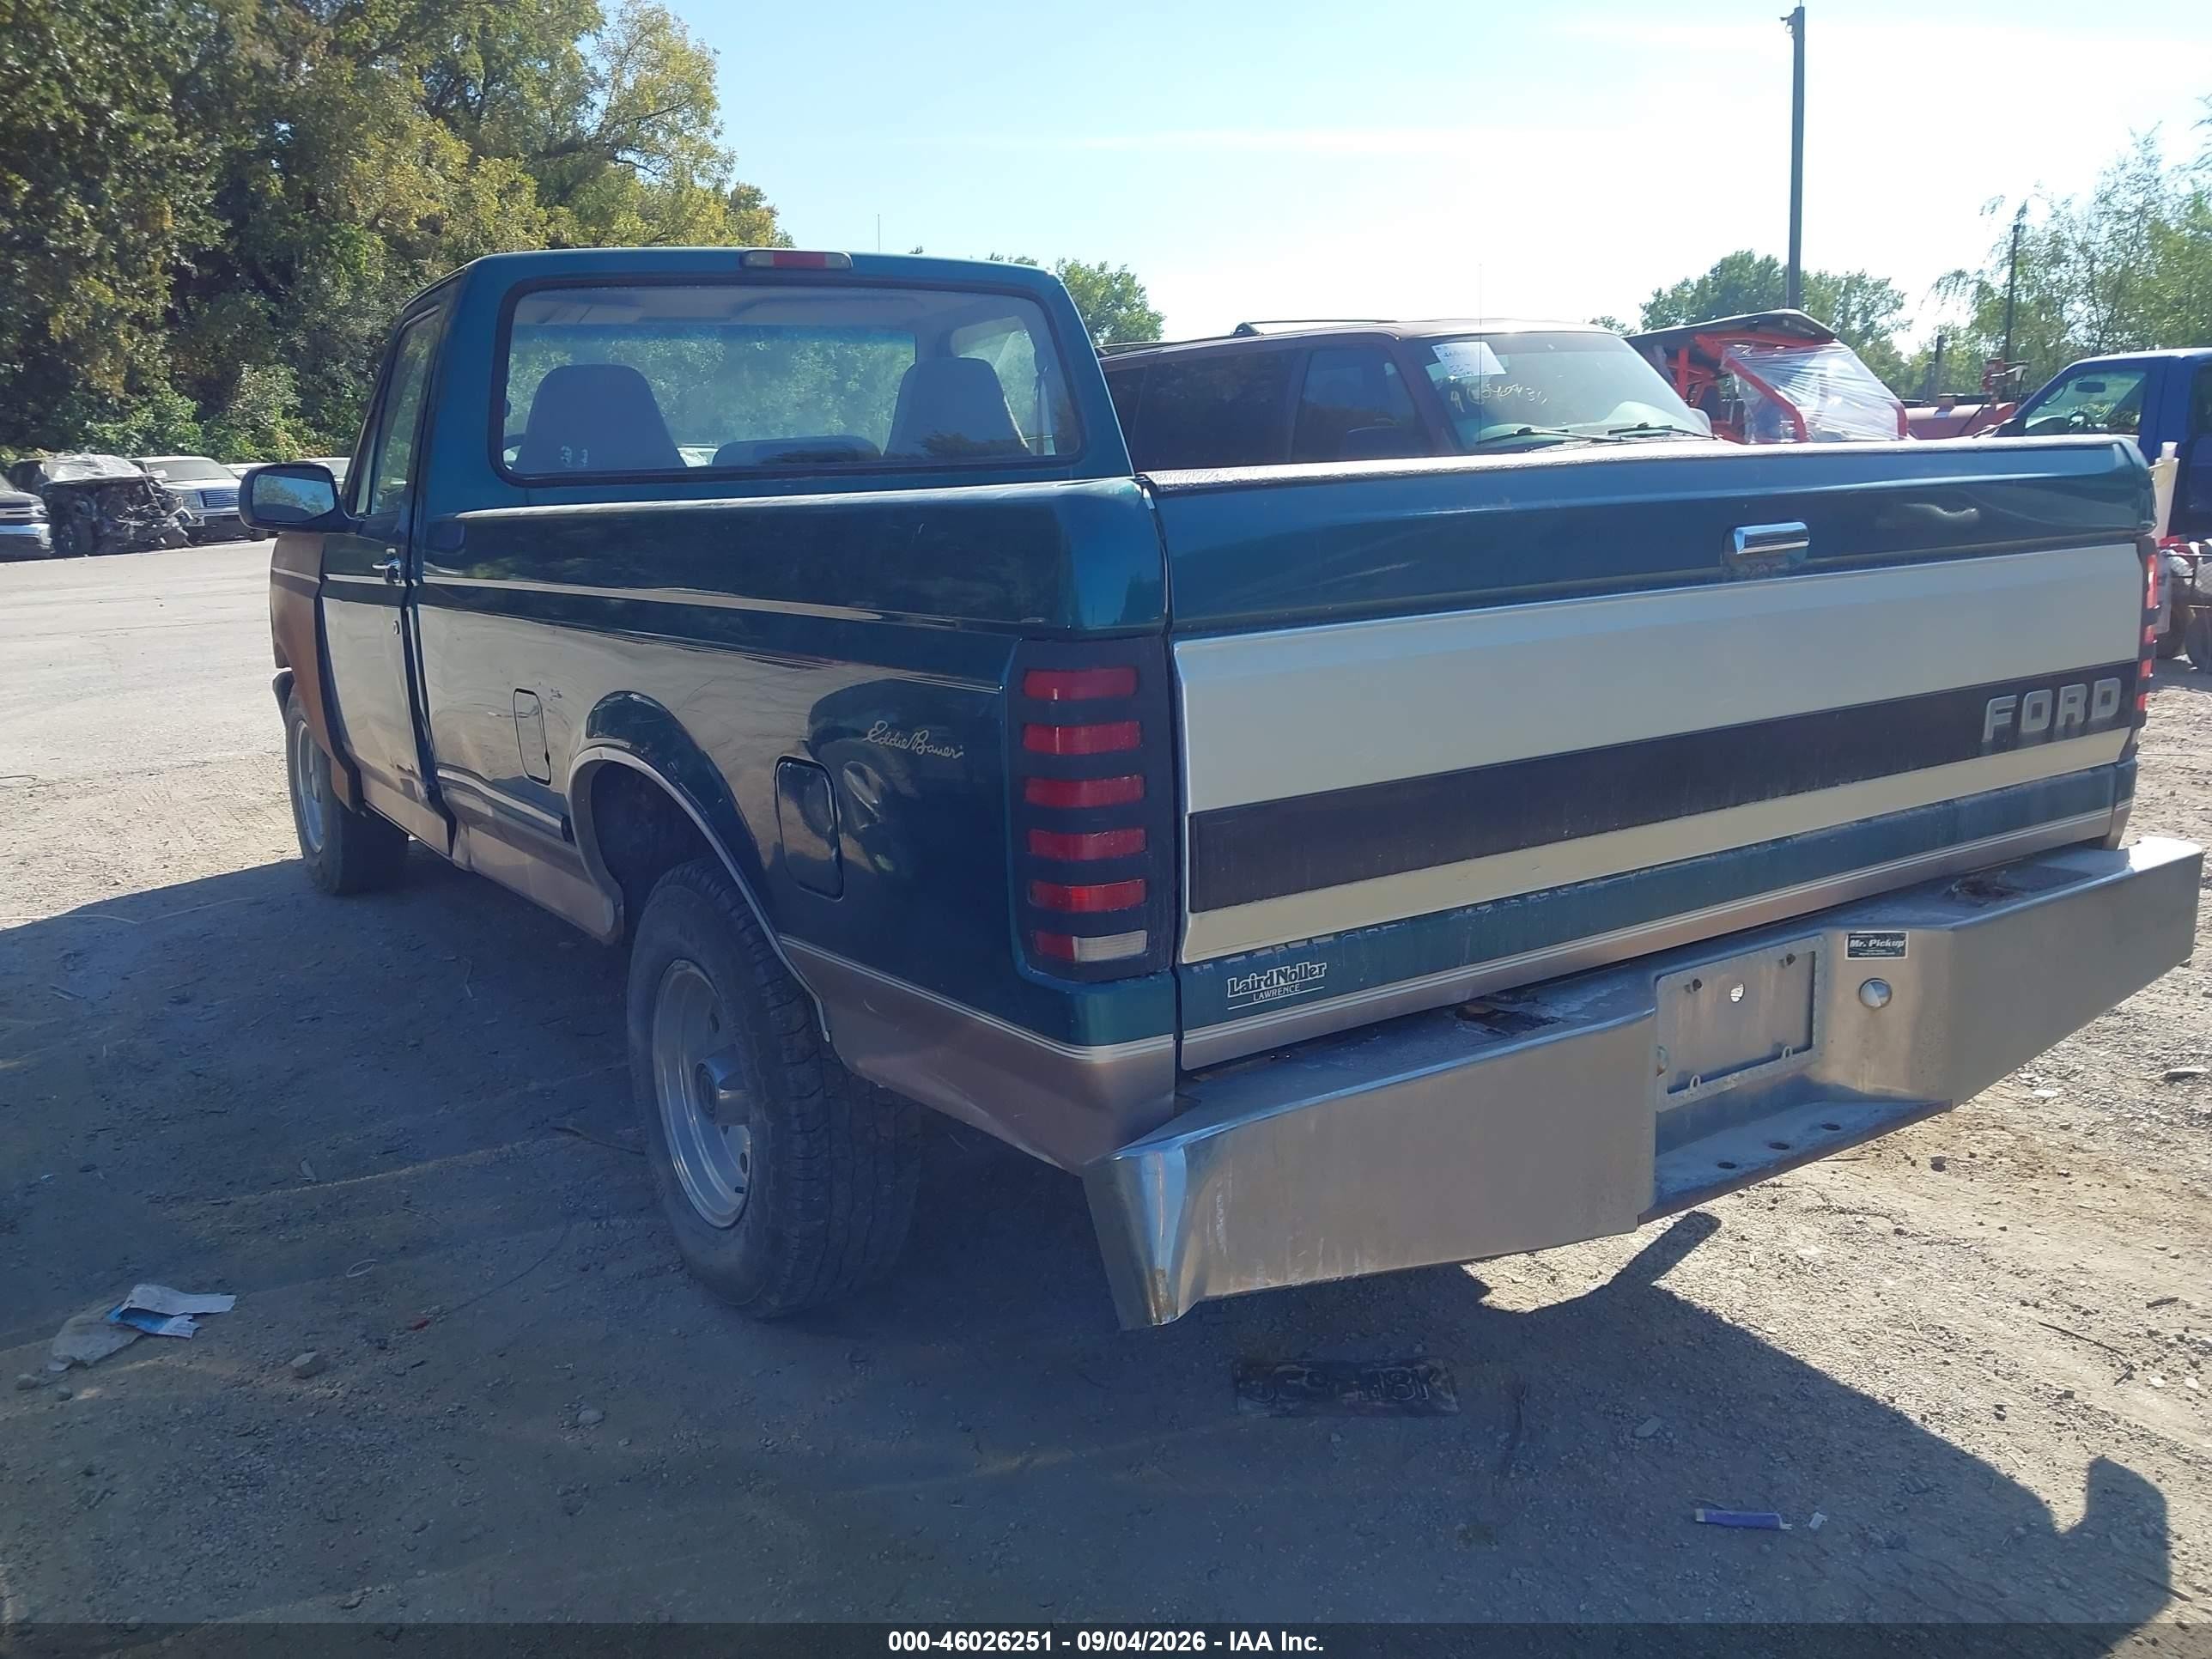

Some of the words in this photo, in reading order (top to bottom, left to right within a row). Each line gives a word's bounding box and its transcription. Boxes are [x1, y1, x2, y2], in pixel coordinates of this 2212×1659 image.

[1982, 678, 2121, 742] FORD
[861, 720, 909, 750] Eddie
[909, 730, 964, 759] Bauer
[1849, 939, 1867, 948] Mr.
[1869, 939, 1905, 948] Pickup
[1253, 983, 1301, 1001] LAWRENCE
